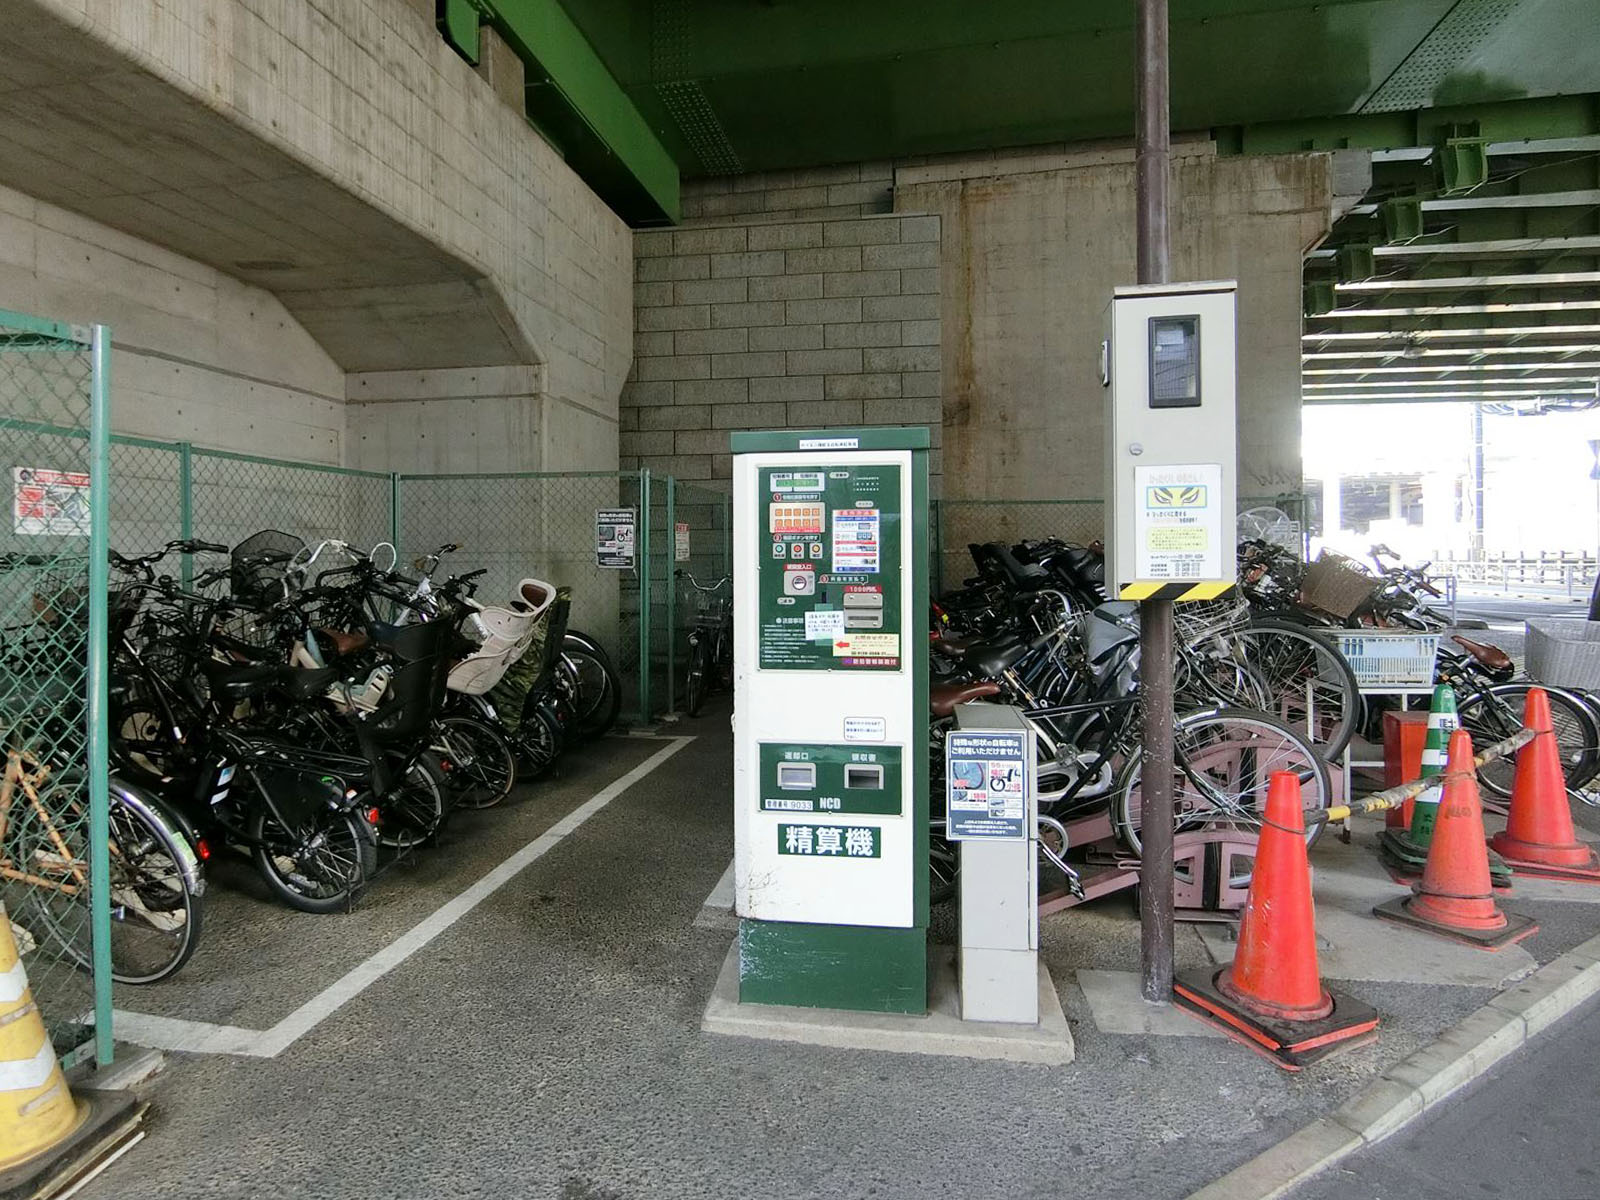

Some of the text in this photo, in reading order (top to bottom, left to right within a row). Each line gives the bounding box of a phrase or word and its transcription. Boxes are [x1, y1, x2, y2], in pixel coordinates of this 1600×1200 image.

[953, 738, 1019, 747] 特殊な形状の自転車は
[951, 747, 1021, 756] ご利用いただけません
[790, 801, 812, 809] 9033
[819, 797, 841, 809] NCD
[785, 826, 874, 856] 精算機
